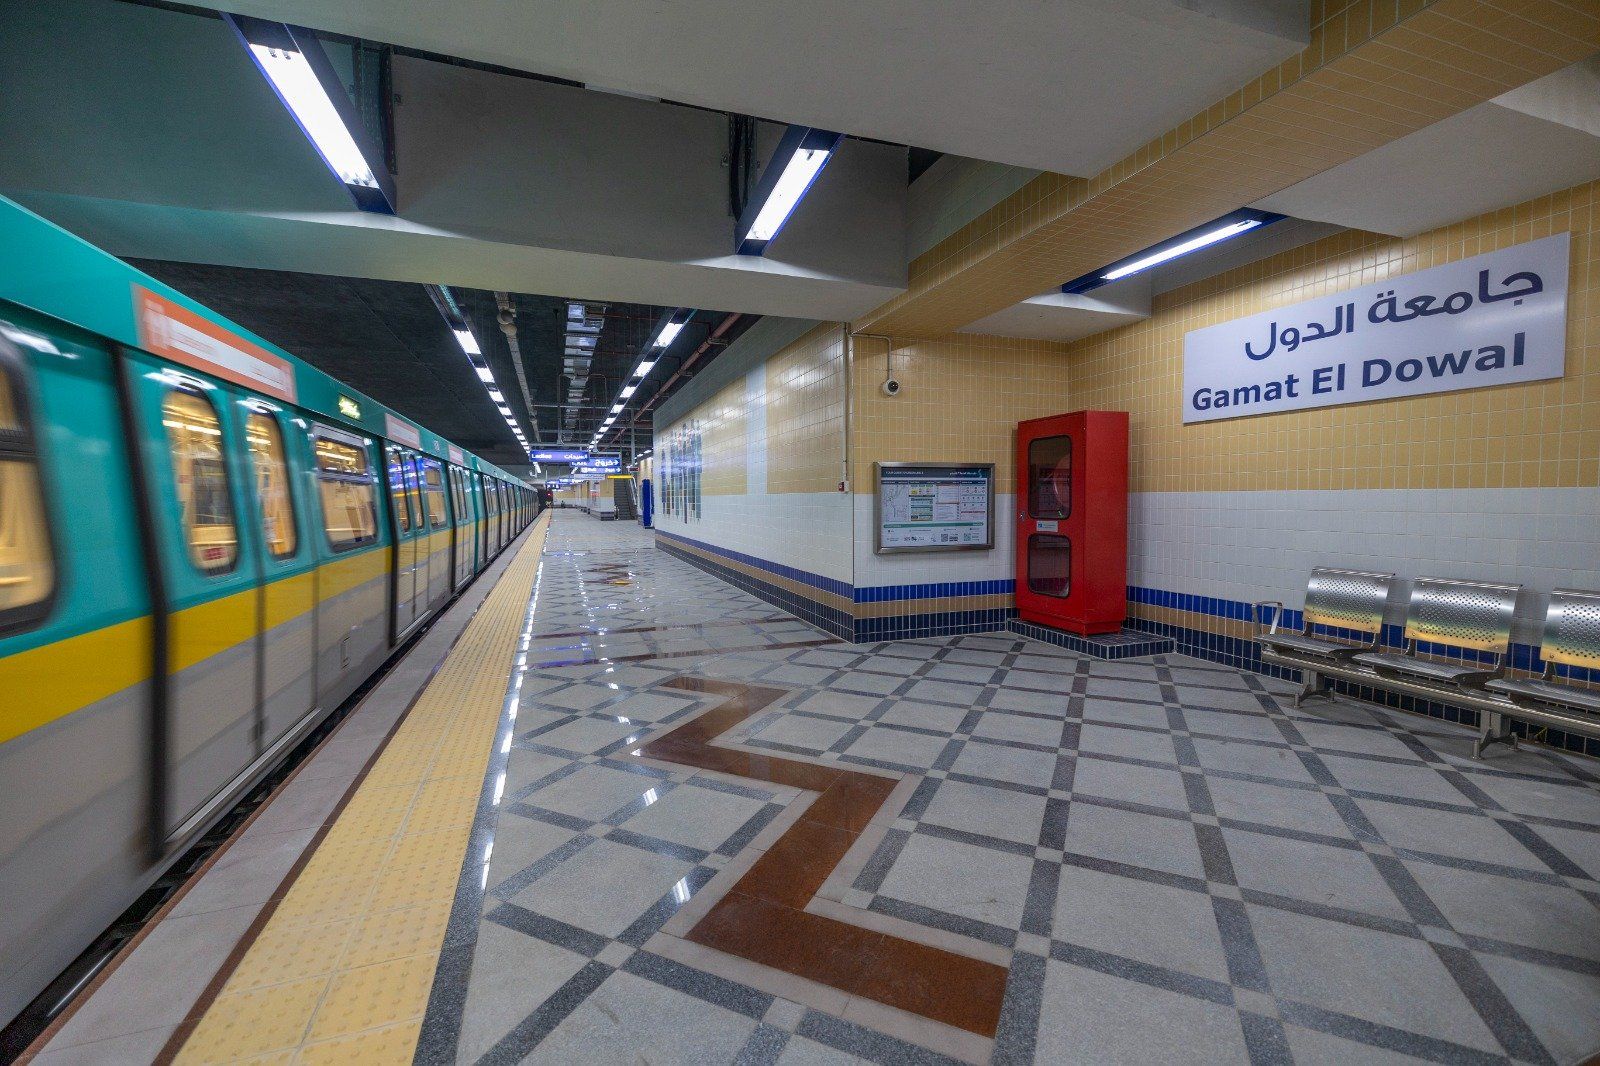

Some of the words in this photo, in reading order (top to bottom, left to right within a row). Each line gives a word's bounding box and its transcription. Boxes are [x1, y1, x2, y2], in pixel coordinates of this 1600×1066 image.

[1367, 268, 1544, 324] جامعة
[1245, 302, 1356, 361] الدول
[1192, 373, 1300, 411] Gamat
[1311, 362, 1346, 395] El
[1361, 331, 1526, 388] Dowal
